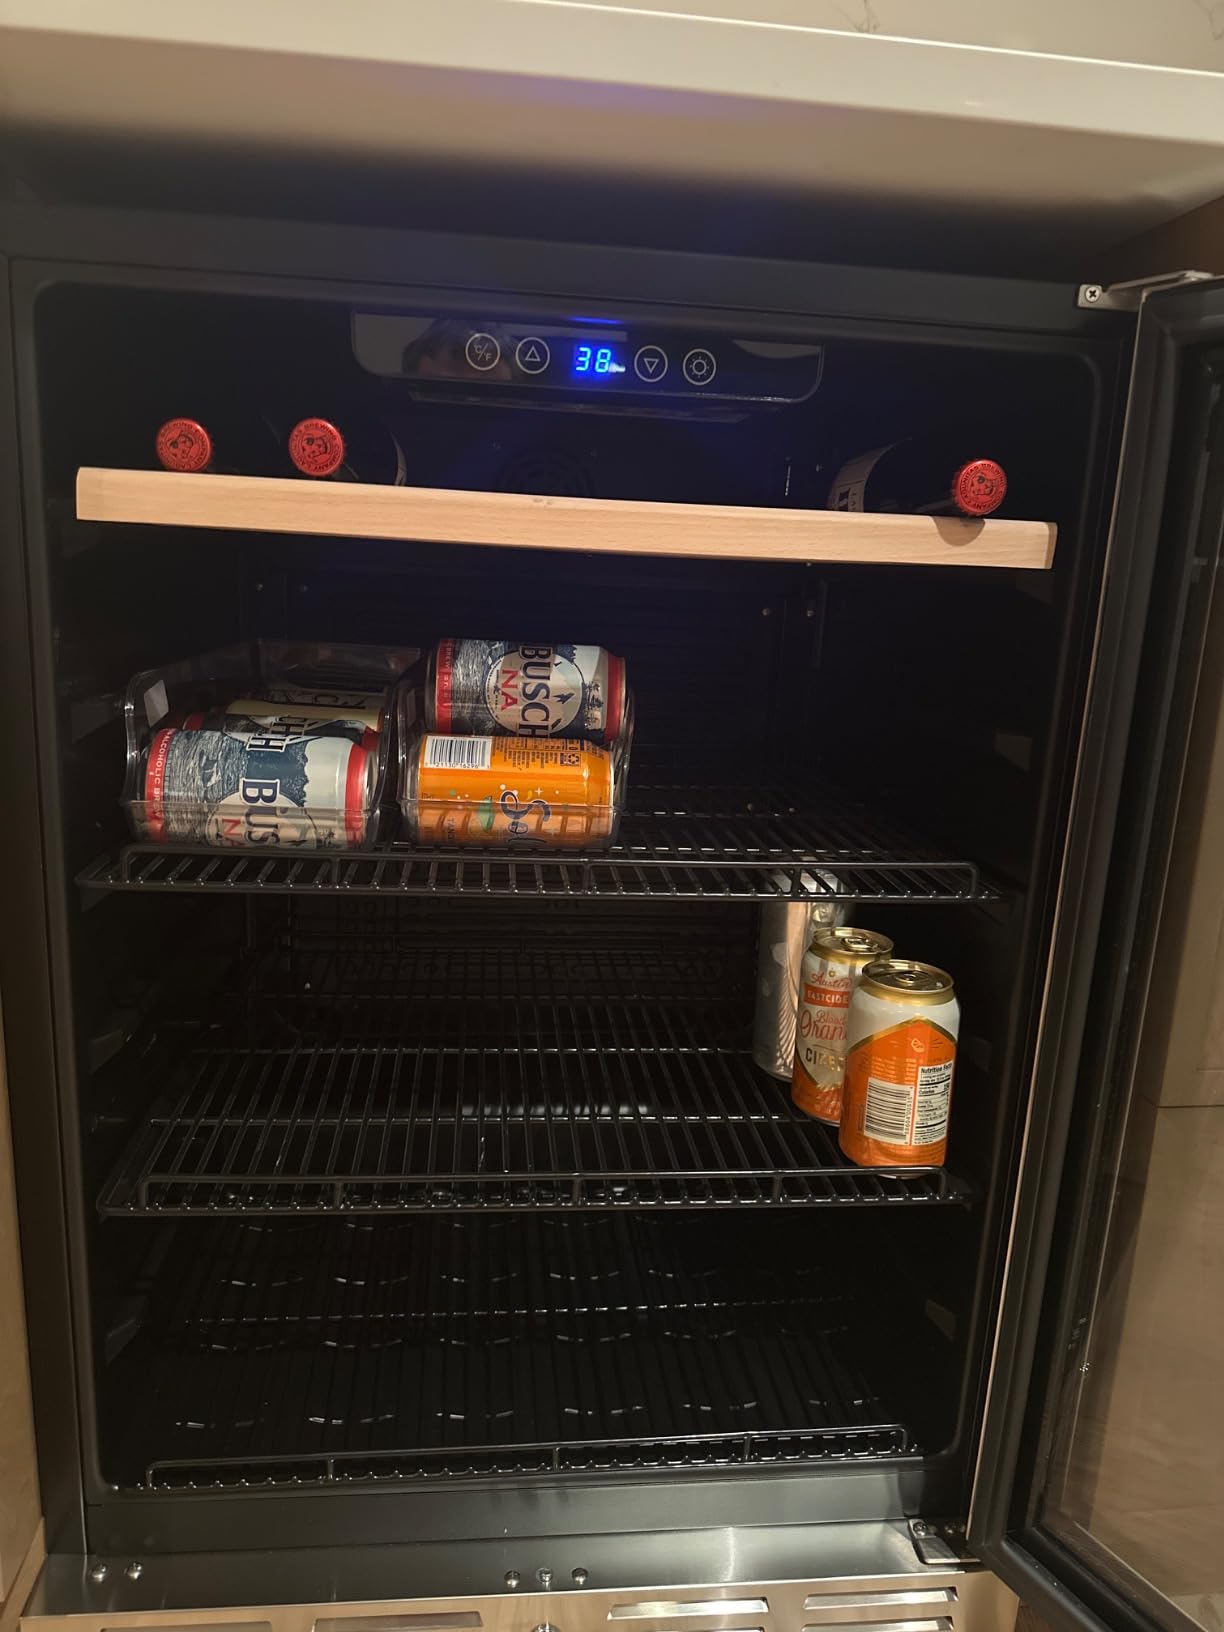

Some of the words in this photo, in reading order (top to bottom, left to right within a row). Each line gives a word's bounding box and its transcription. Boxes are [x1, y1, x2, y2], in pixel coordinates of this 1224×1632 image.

[576, 347, 611, 372] 38
[501, 669, 519, 710] NA
[518, 646, 552, 738] BUSCH
[811, 971, 853, 988] Austin
